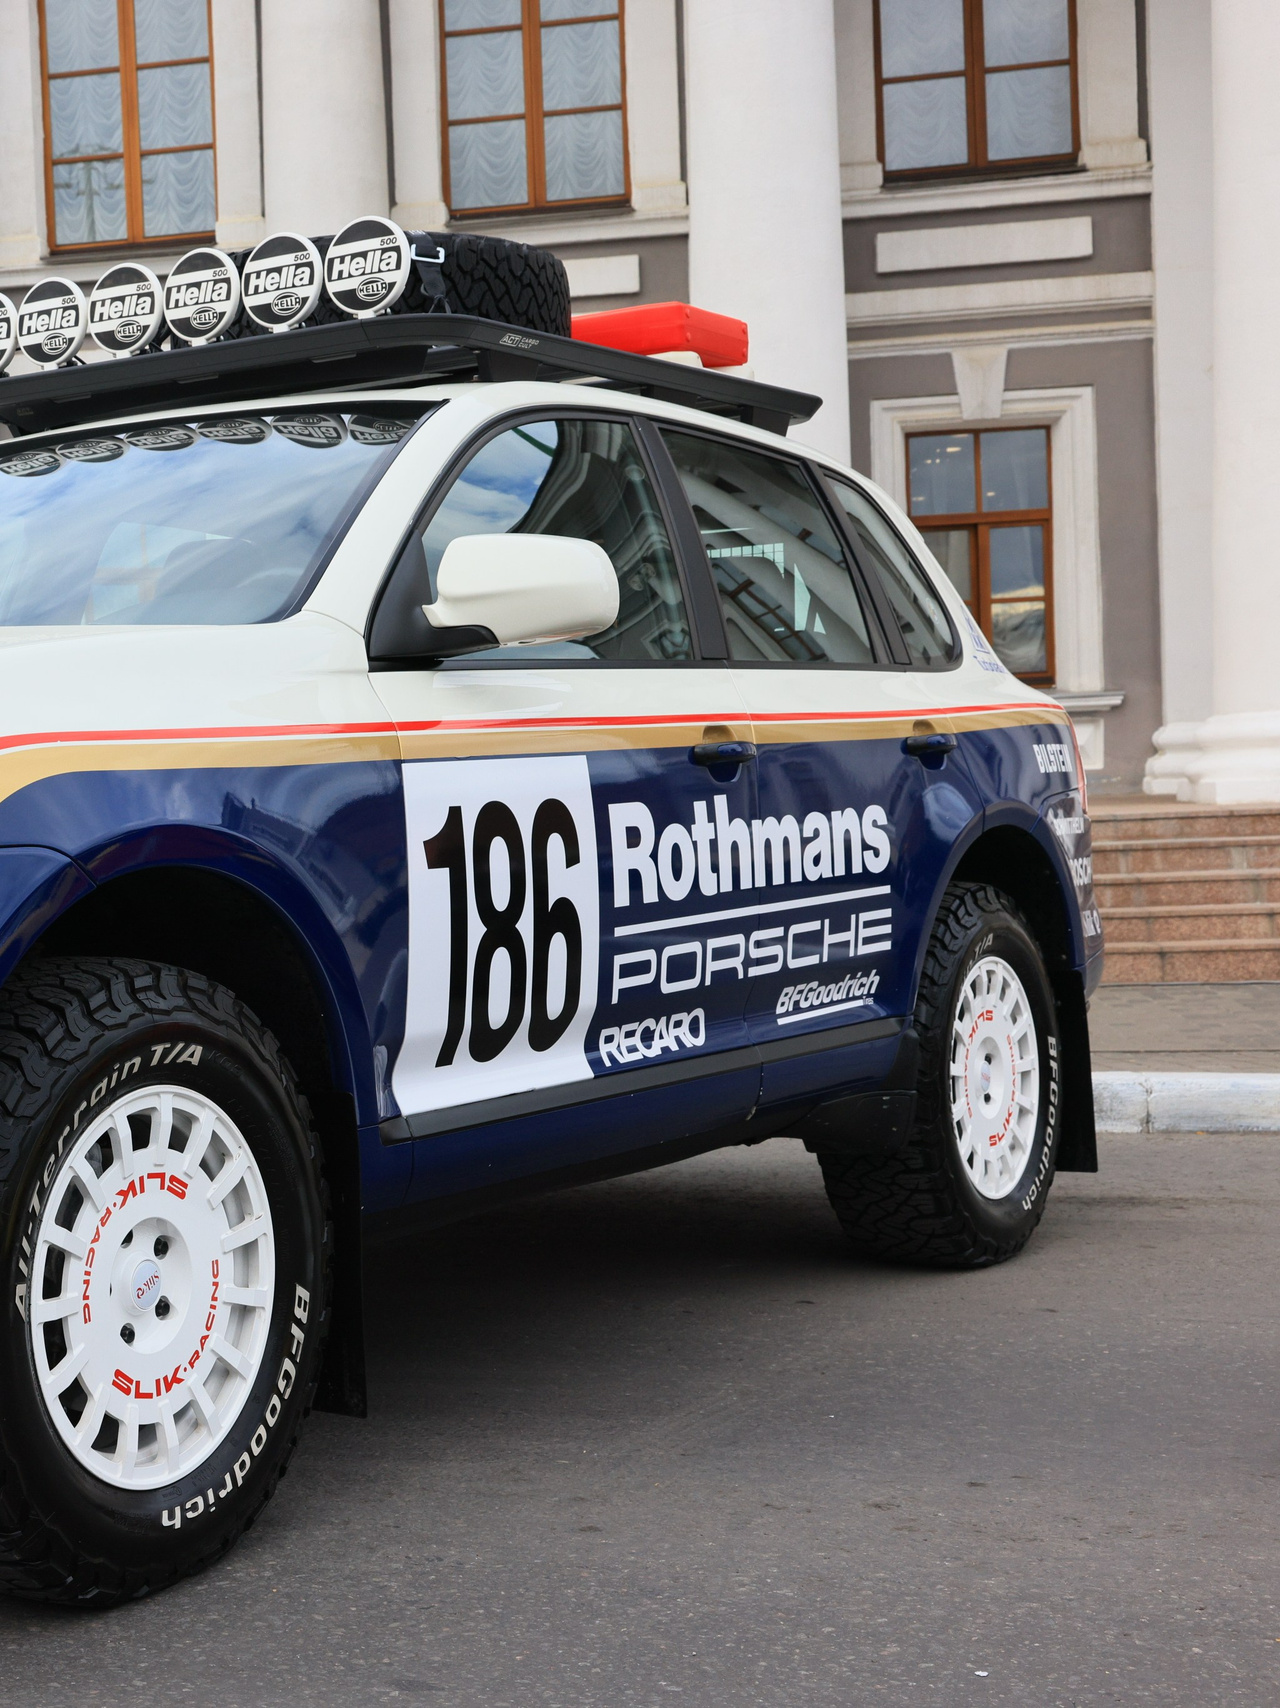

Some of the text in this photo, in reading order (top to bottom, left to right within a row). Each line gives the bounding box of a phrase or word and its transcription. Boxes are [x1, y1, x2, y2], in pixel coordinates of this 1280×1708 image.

[380, 236, 398, 246] 500
[294, 252, 310, 262] 500
[330, 250, 398, 280] Hella
[136, 283, 152, 292] 500
[212, 268, 228, 278] 500
[248, 265, 311, 294] Hella
[61, 296, 76, 305] 500
[93, 294, 152, 322] Hella
[168, 280, 228, 308] Hella
[22, 308, 76, 336] Hella
[502, 335, 520, 345] ACT
[1032, 744, 1072, 774] BILSTEIN
[608, 794, 892, 908] Rothmans
[422, 797, 583, 1069] 186
[612, 908, 893, 1005] PORSCHE
[776, 969, 880, 1014] BFGoodrich
[598, 1007, 706, 1068] RECARO
[1022, 1034, 1061, 1212] BFGoodrich
[14, 1060, 142, 1324] All-Terrain
[150, 1043, 204, 1067] T/A
[160, 1282, 310, 1531] BFGoodrich
